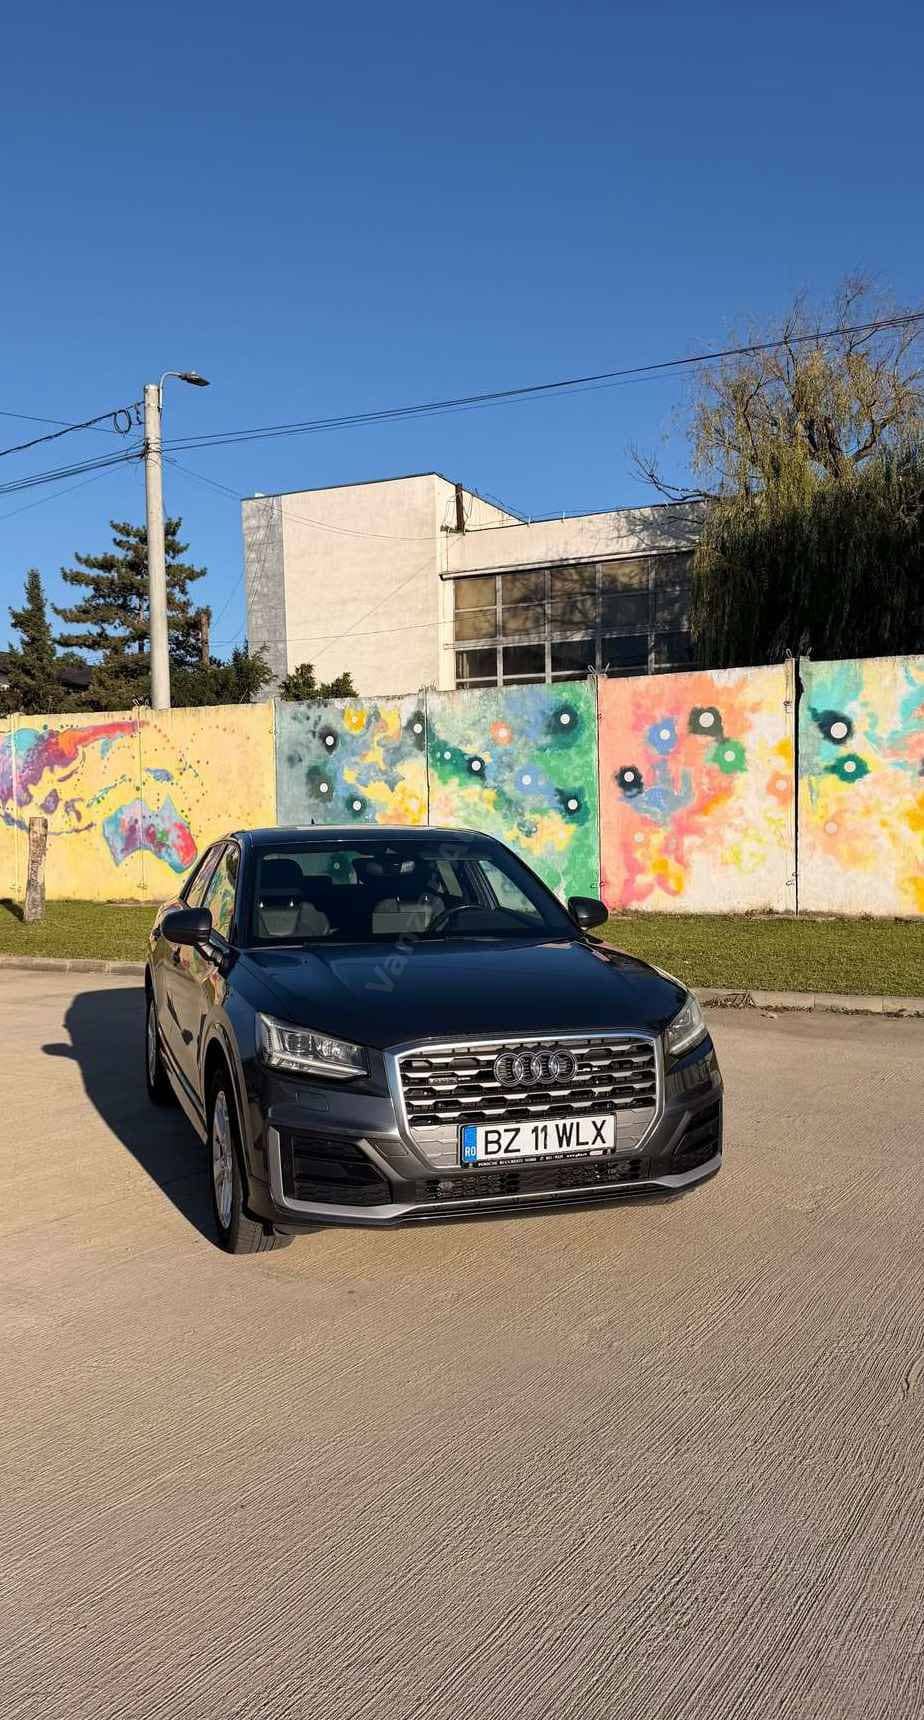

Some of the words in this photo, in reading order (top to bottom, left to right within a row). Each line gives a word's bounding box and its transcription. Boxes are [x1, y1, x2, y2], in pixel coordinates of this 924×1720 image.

[484, 1128, 520, 1155] BZ
[532, 1125, 548, 1151] 11
[555, 1120, 606, 1148] WLX
[465, 1146, 476, 1157] RO
